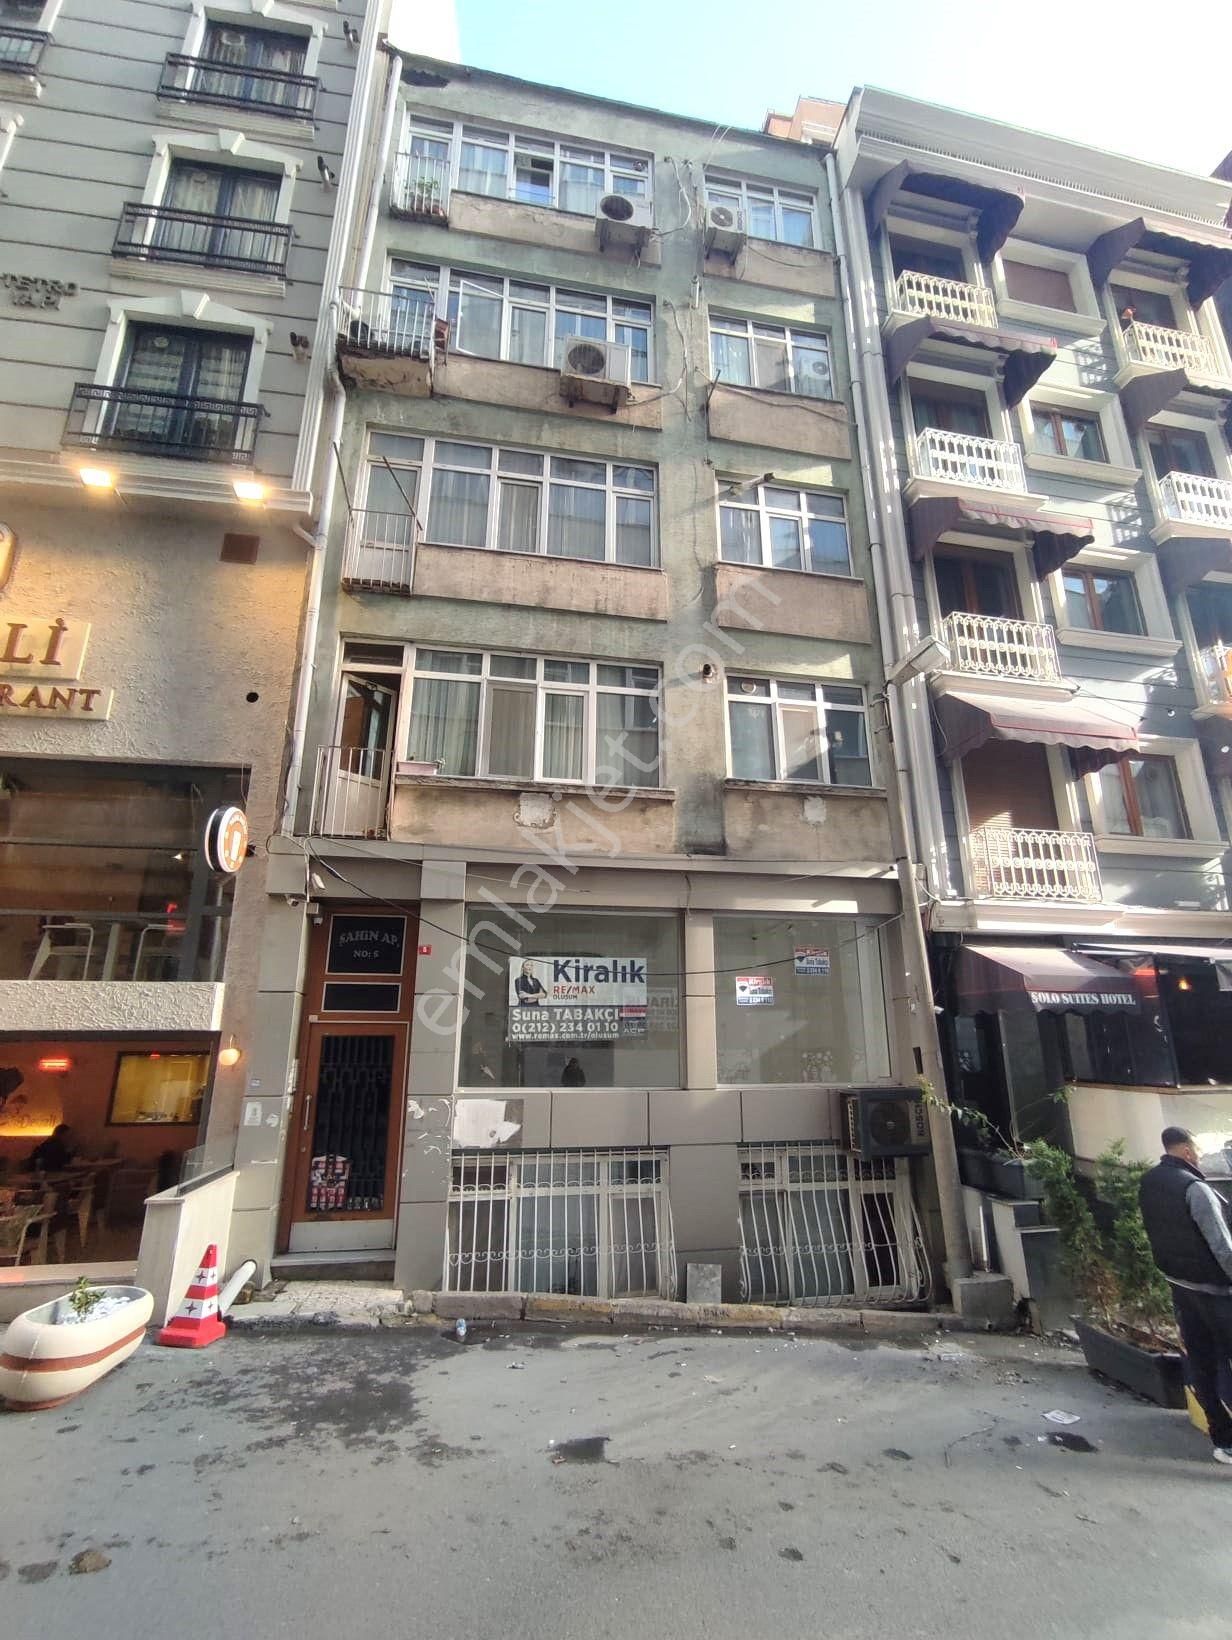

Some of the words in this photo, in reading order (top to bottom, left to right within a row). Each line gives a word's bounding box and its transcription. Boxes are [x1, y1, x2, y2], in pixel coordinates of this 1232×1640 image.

[553, 959, 646, 983] Kiralık
[553, 985, 596, 994] RE/MAX
[1061, 992, 1099, 1005] SUITES
[1100, 993, 1137, 1006] HOTEL
[512, 1008, 549, 1020] Suna
[553, 1008, 619, 1021] TABAKÇI
[512, 1022, 556, 1033] 0(212)
[559, 1022, 583, 1032] 234
